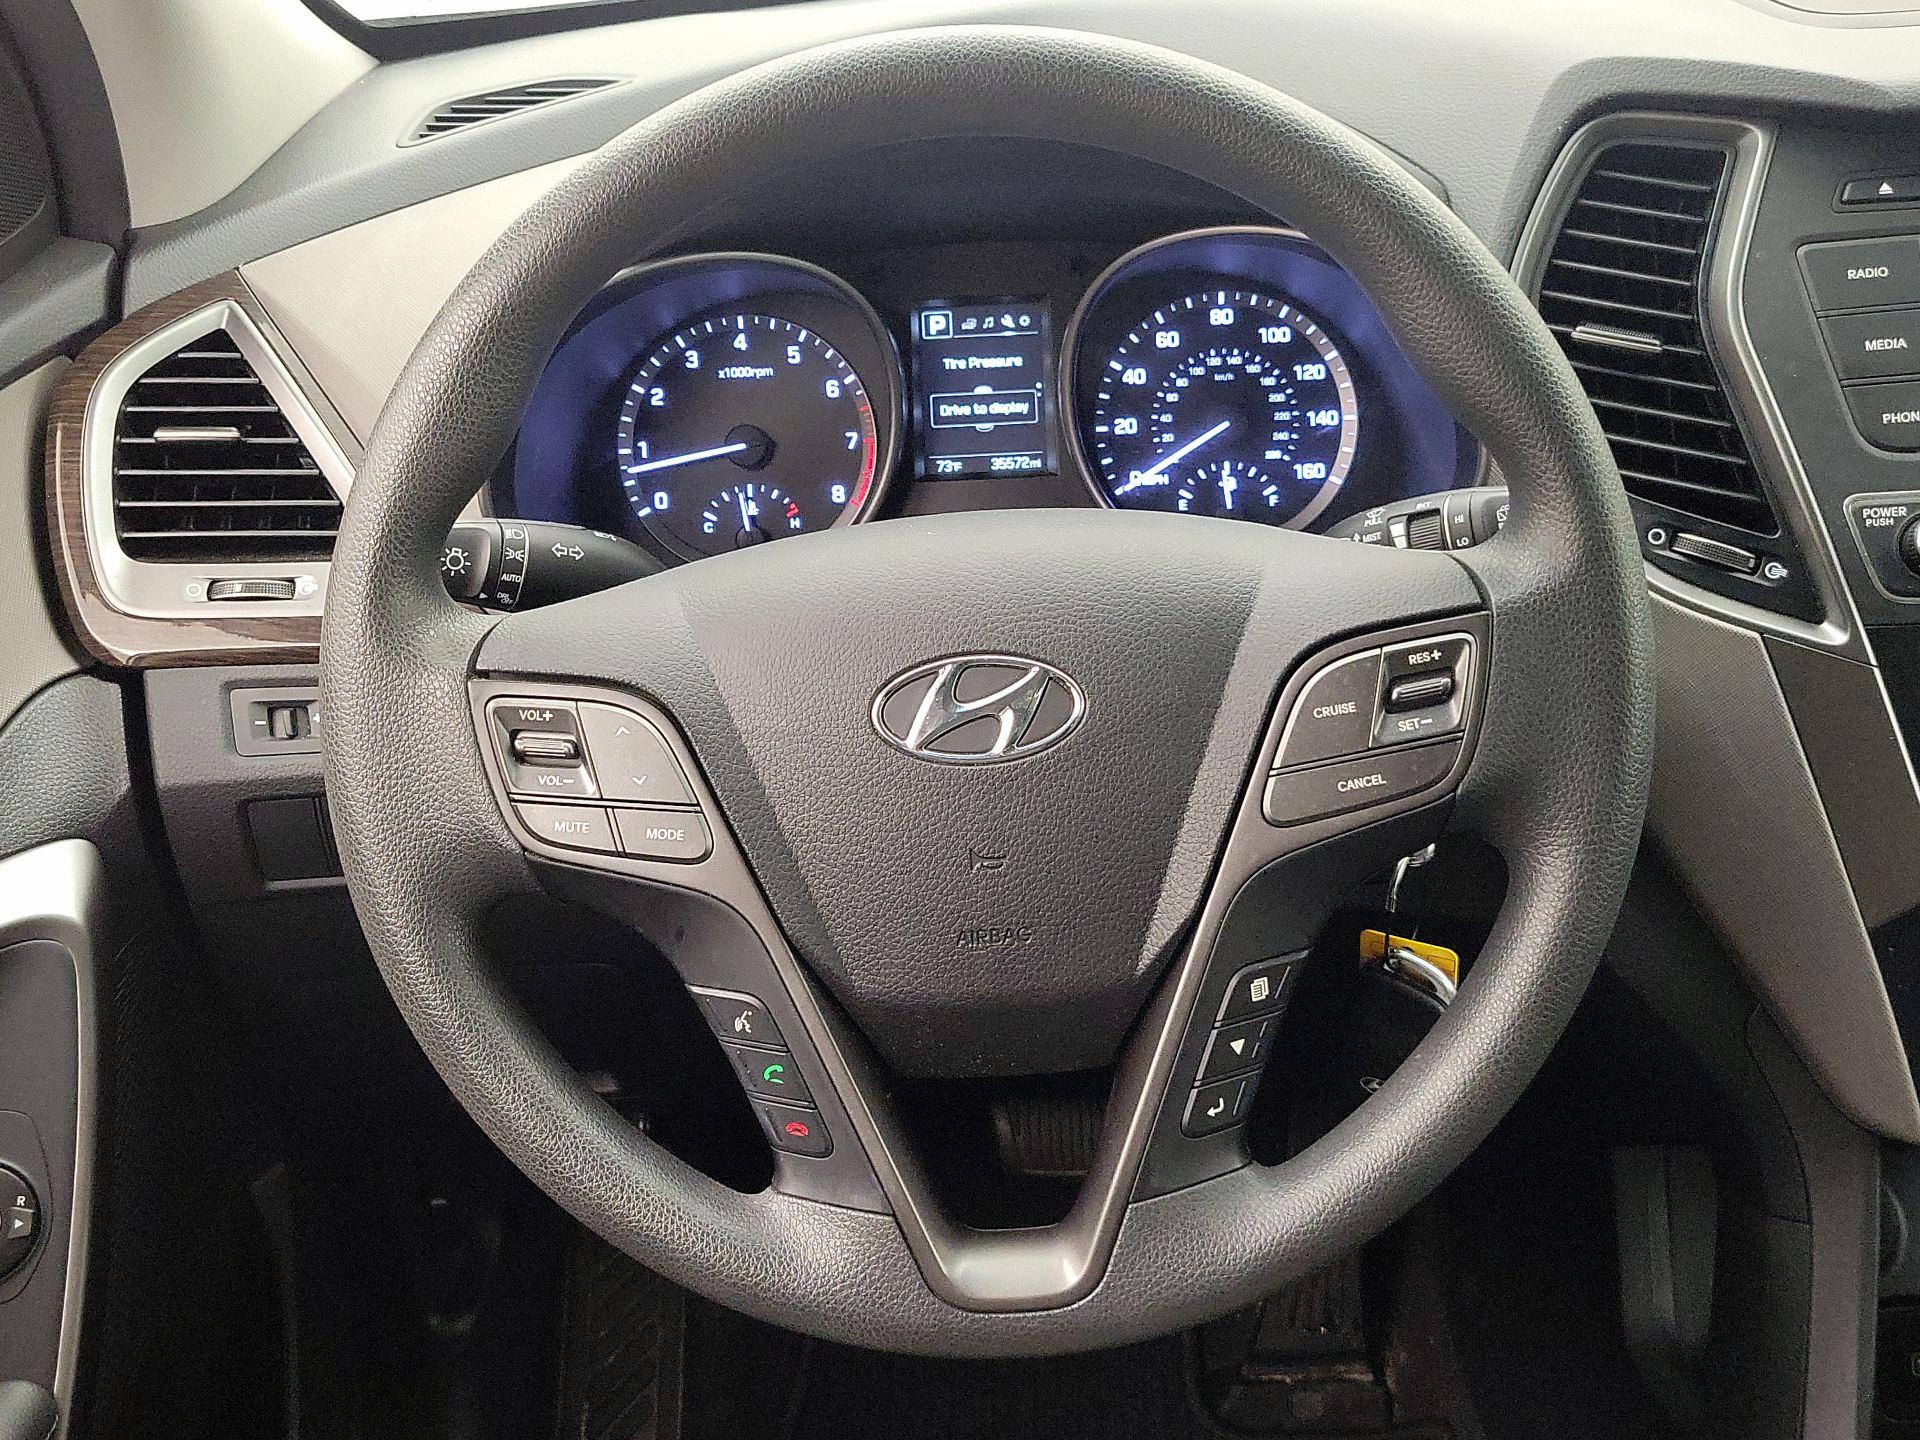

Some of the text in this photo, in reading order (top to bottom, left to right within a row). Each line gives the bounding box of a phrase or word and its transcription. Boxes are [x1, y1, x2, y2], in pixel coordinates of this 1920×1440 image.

[1847, 266, 1889, 280] RADIO
[1209, 308, 1234, 325] 80
[929, 315, 946, 335] P
[733, 333, 747, 351] 4
[1155, 331, 1180, 348] 60
[1258, 326, 1292, 343] 100
[1864, 338, 1908, 351] MEDIA
[684, 350, 699, 369] 3
[787, 345, 801, 365] 5
[943, 356, 1023, 370] Tire Pressure
[717, 366, 774, 379] x1000rpm
[1122, 367, 1147, 385] 40
[1188, 366, 1205, 376] 100
[1214, 373, 1235, 381] km/h
[1293, 363, 1326, 380] 120
[825, 379, 840, 398] 6
[650, 387, 664, 406] 2
[939, 402, 1029, 417] Drive to display
[1882, 410, 1920, 424] PHON
[1306, 410, 1339, 427] 140
[1113, 418, 1138, 435] 20
[844, 431, 858, 450] 7
[637, 441, 648, 459] 1
[1293, 463, 1326, 480] 160
[653, 491, 668, 510] 0
[831, 485, 846, 504] 8
[1269, 495, 1278, 507] F
[1178, 499, 1188, 510] E
[1454, 514, 1465, 524] HI
[1862, 506, 1907, 519] POWER
[703, 521, 714, 533] C
[790, 517, 800, 529] H
[1363, 519, 1383, 528] PULL
[1865, 517, 1894, 527] PUSH
[1362, 531, 1382, 543] MIST
[1456, 537, 1470, 546] LO
[501, 573, 521, 583] AUTO
[1313, 701, 1357, 719] CRUISE
[1337, 773, 1387, 793] CANCEL
[554, 820, 590, 834] MUTE
[646, 827, 685, 841] MODE
[957, 926, 1032, 946] AIRBAG
[16, 1195, 26, 1206] R
